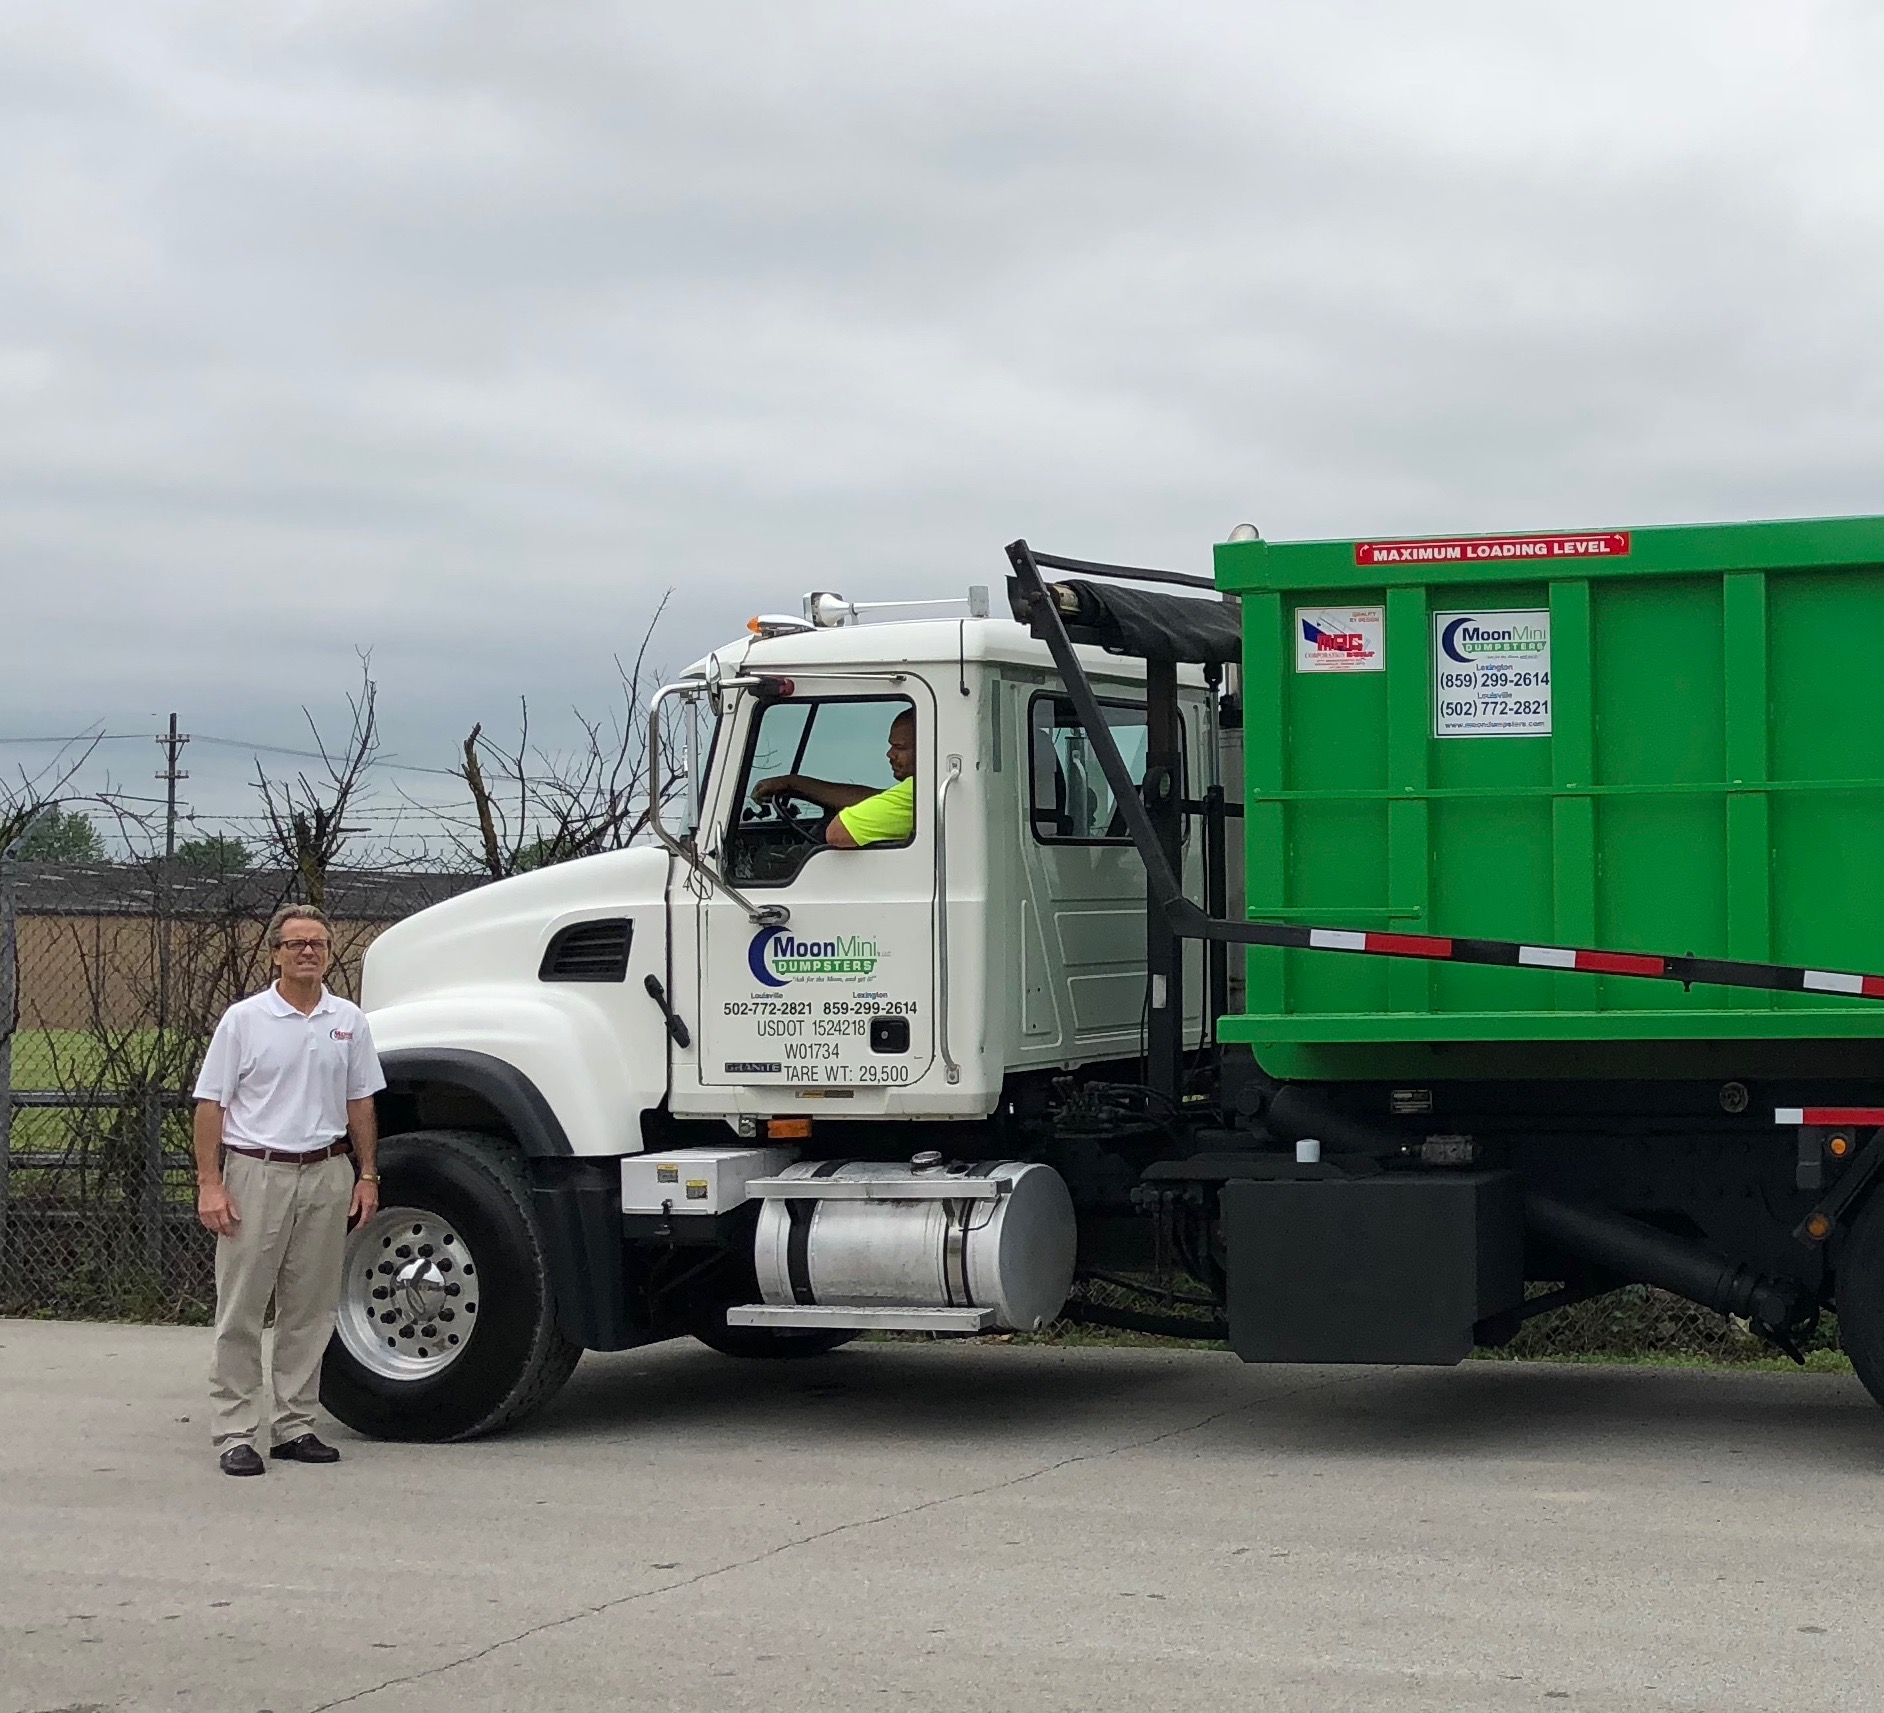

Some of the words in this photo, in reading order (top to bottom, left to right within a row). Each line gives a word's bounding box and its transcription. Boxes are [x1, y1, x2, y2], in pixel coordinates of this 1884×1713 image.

[1373, 546, 1461, 562] MAXIMUM
[1467, 543, 1547, 558] LOADING
[1553, 541, 1610, 554] LEVEL
[1465, 642, 1544, 652] DUMPSTERS
[1476, 664, 1513, 672] Lexington
[1440, 672, 1478, 690] (859)
[1481, 671, 1550, 687] 299-2614
[1477, 691, 1513, 699] Louisville
[1440, 700, 1478, 718] (502)
[1481, 700, 1549, 715] 772-2821
[779, 961, 873, 971] DUMPSTERS
[852, 991, 888, 1000] Lexington
[723, 1002, 813, 1016] 502-772-2821
[823, 1001, 918, 1015] 859-299-2614
[757, 1020, 805, 1036] USDOT
[812, 1019, 866, 1036] 1524218
[784, 1043, 840, 1059] W01734
[784, 1065, 819, 1082] TARE
[825, 1065, 853, 1082] WT:
[859, 1065, 909, 1084] 29,500
